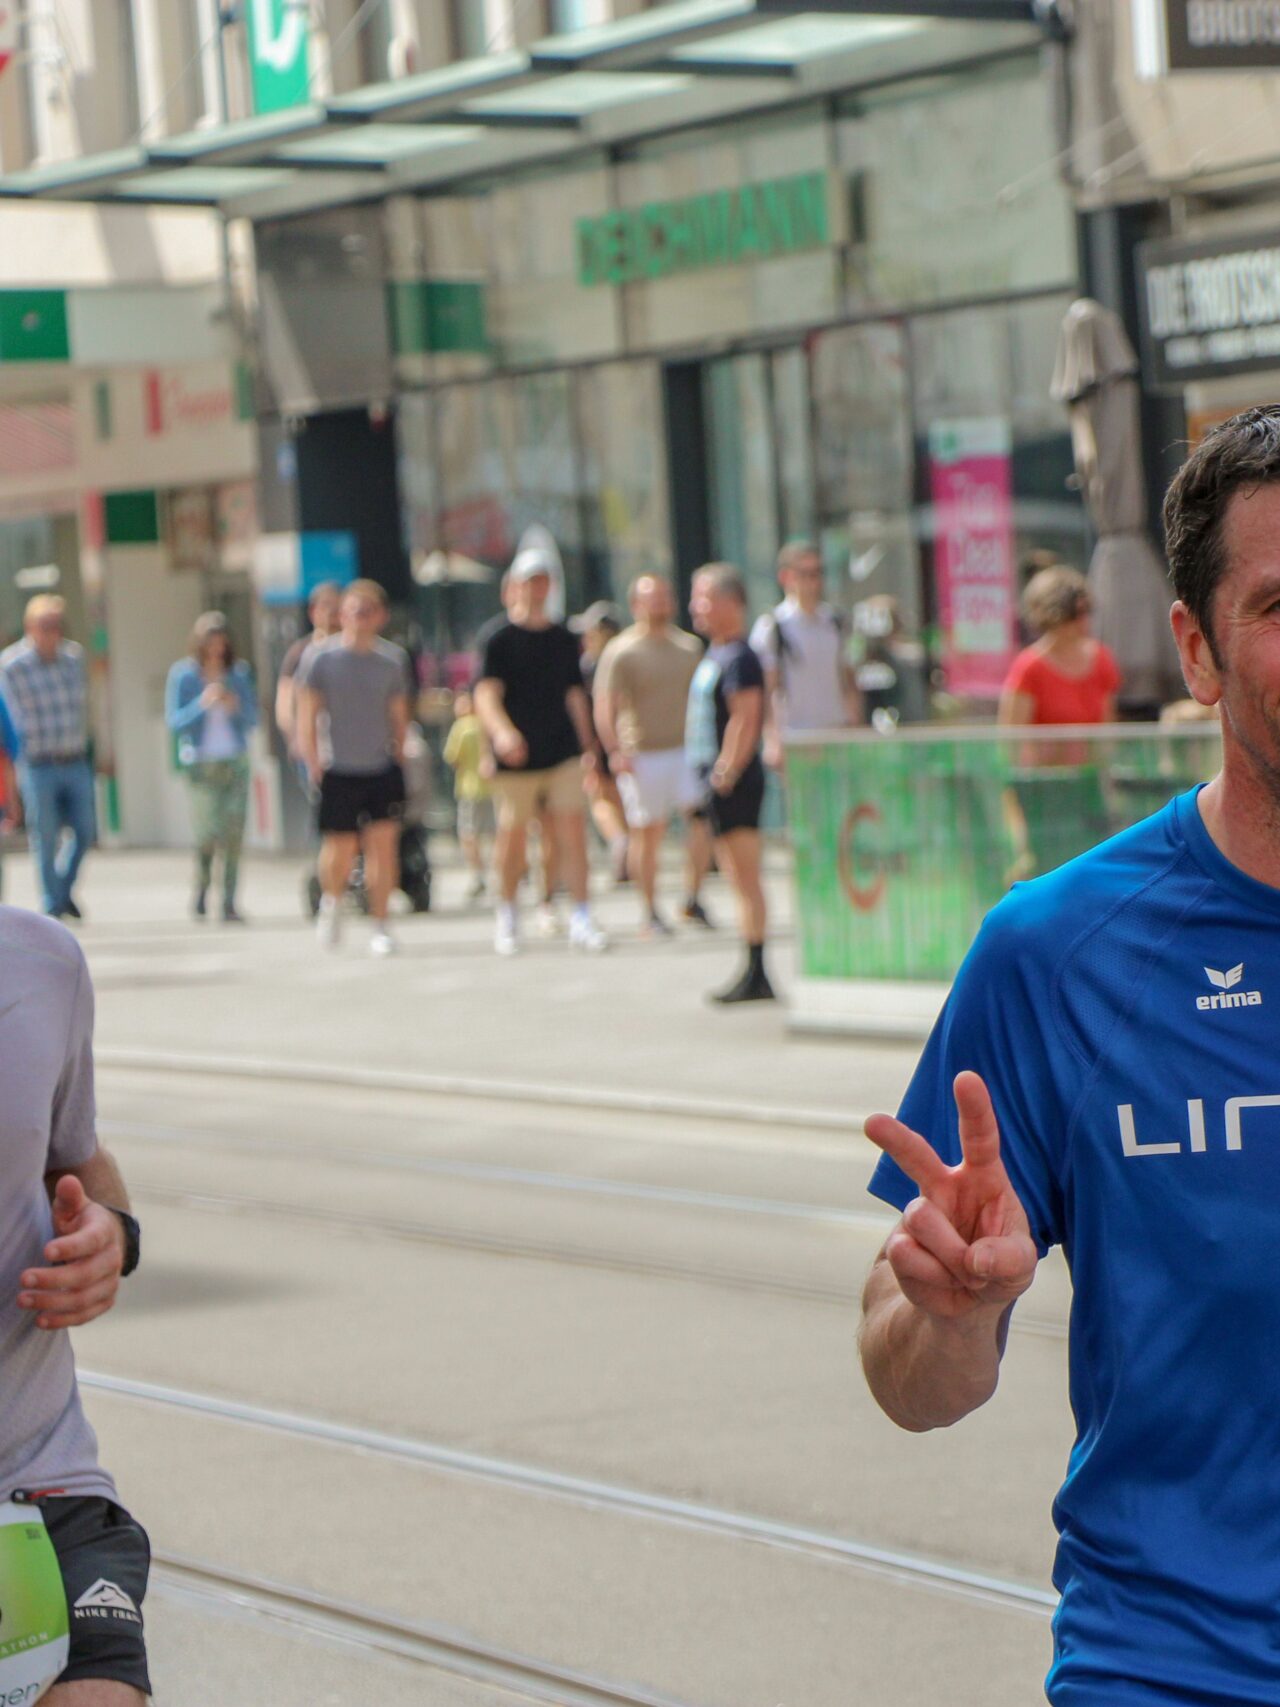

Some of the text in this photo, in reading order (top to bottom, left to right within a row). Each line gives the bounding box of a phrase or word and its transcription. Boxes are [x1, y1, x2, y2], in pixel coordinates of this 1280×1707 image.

[576, 170, 828, 287] DEICHMANN
[1196, 991, 1262, 1010] erima
[74, 1608, 108, 1619] NIKE
